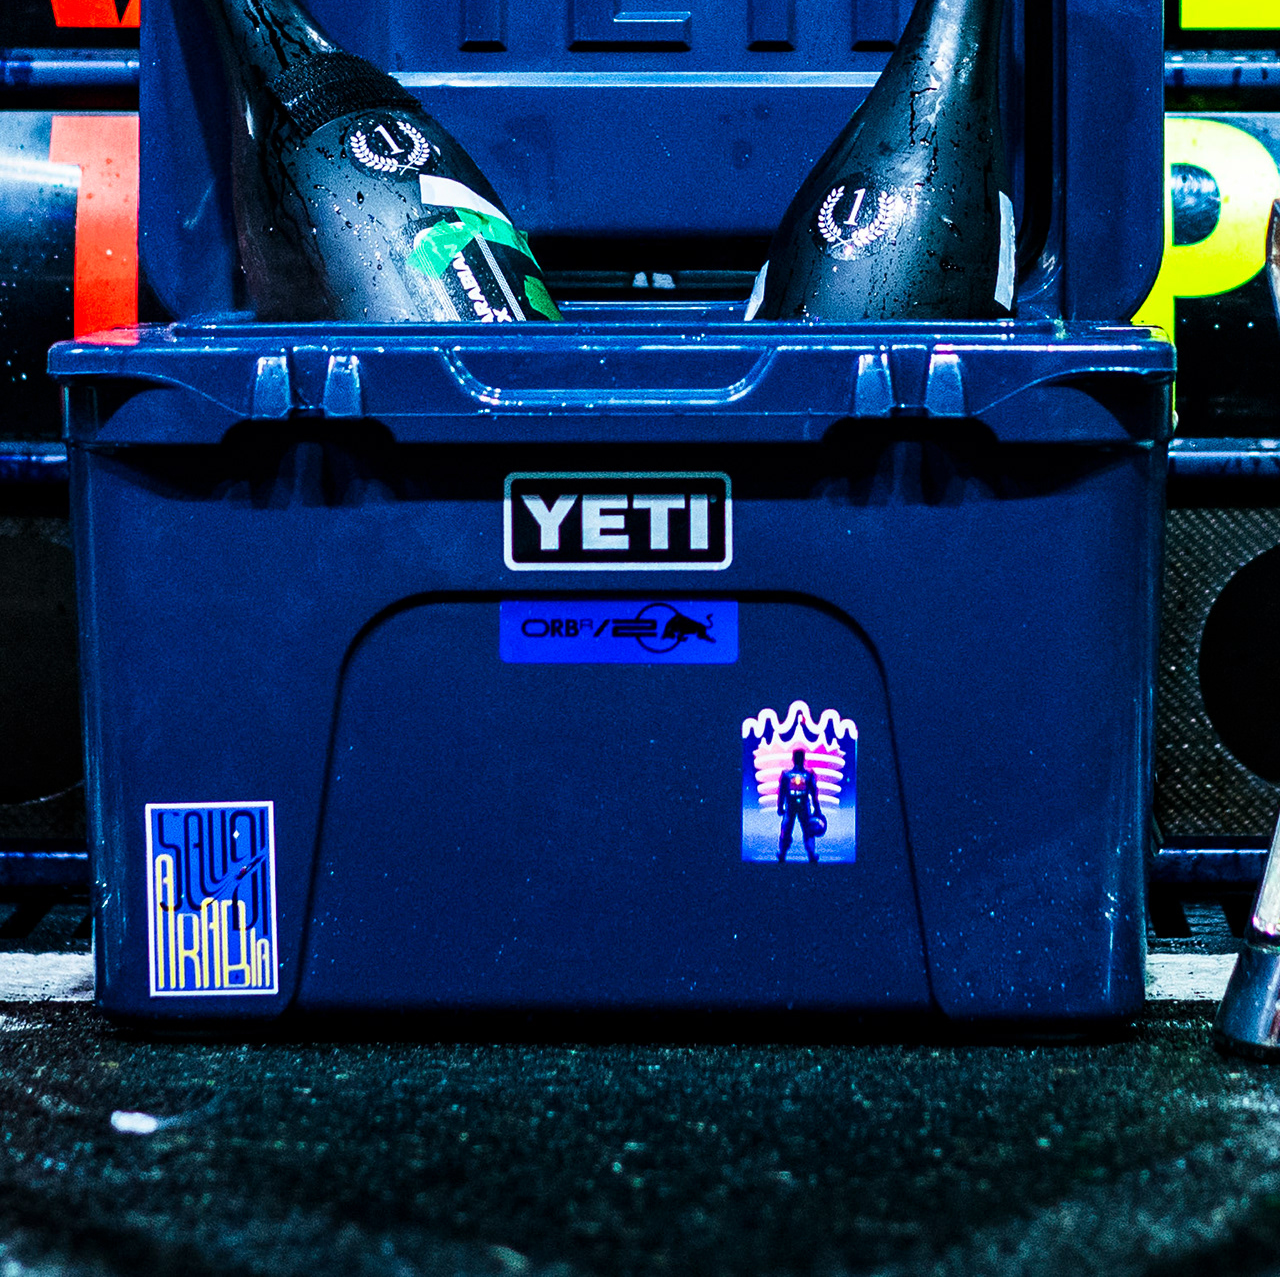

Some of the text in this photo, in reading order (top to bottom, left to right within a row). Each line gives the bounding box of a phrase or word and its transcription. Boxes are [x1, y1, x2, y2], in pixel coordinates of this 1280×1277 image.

[374, 124, 405, 156] 1
[843, 187, 867, 226] 1
[521, 494, 709, 550] YETI
[155, 853, 271, 990] ARABIA
